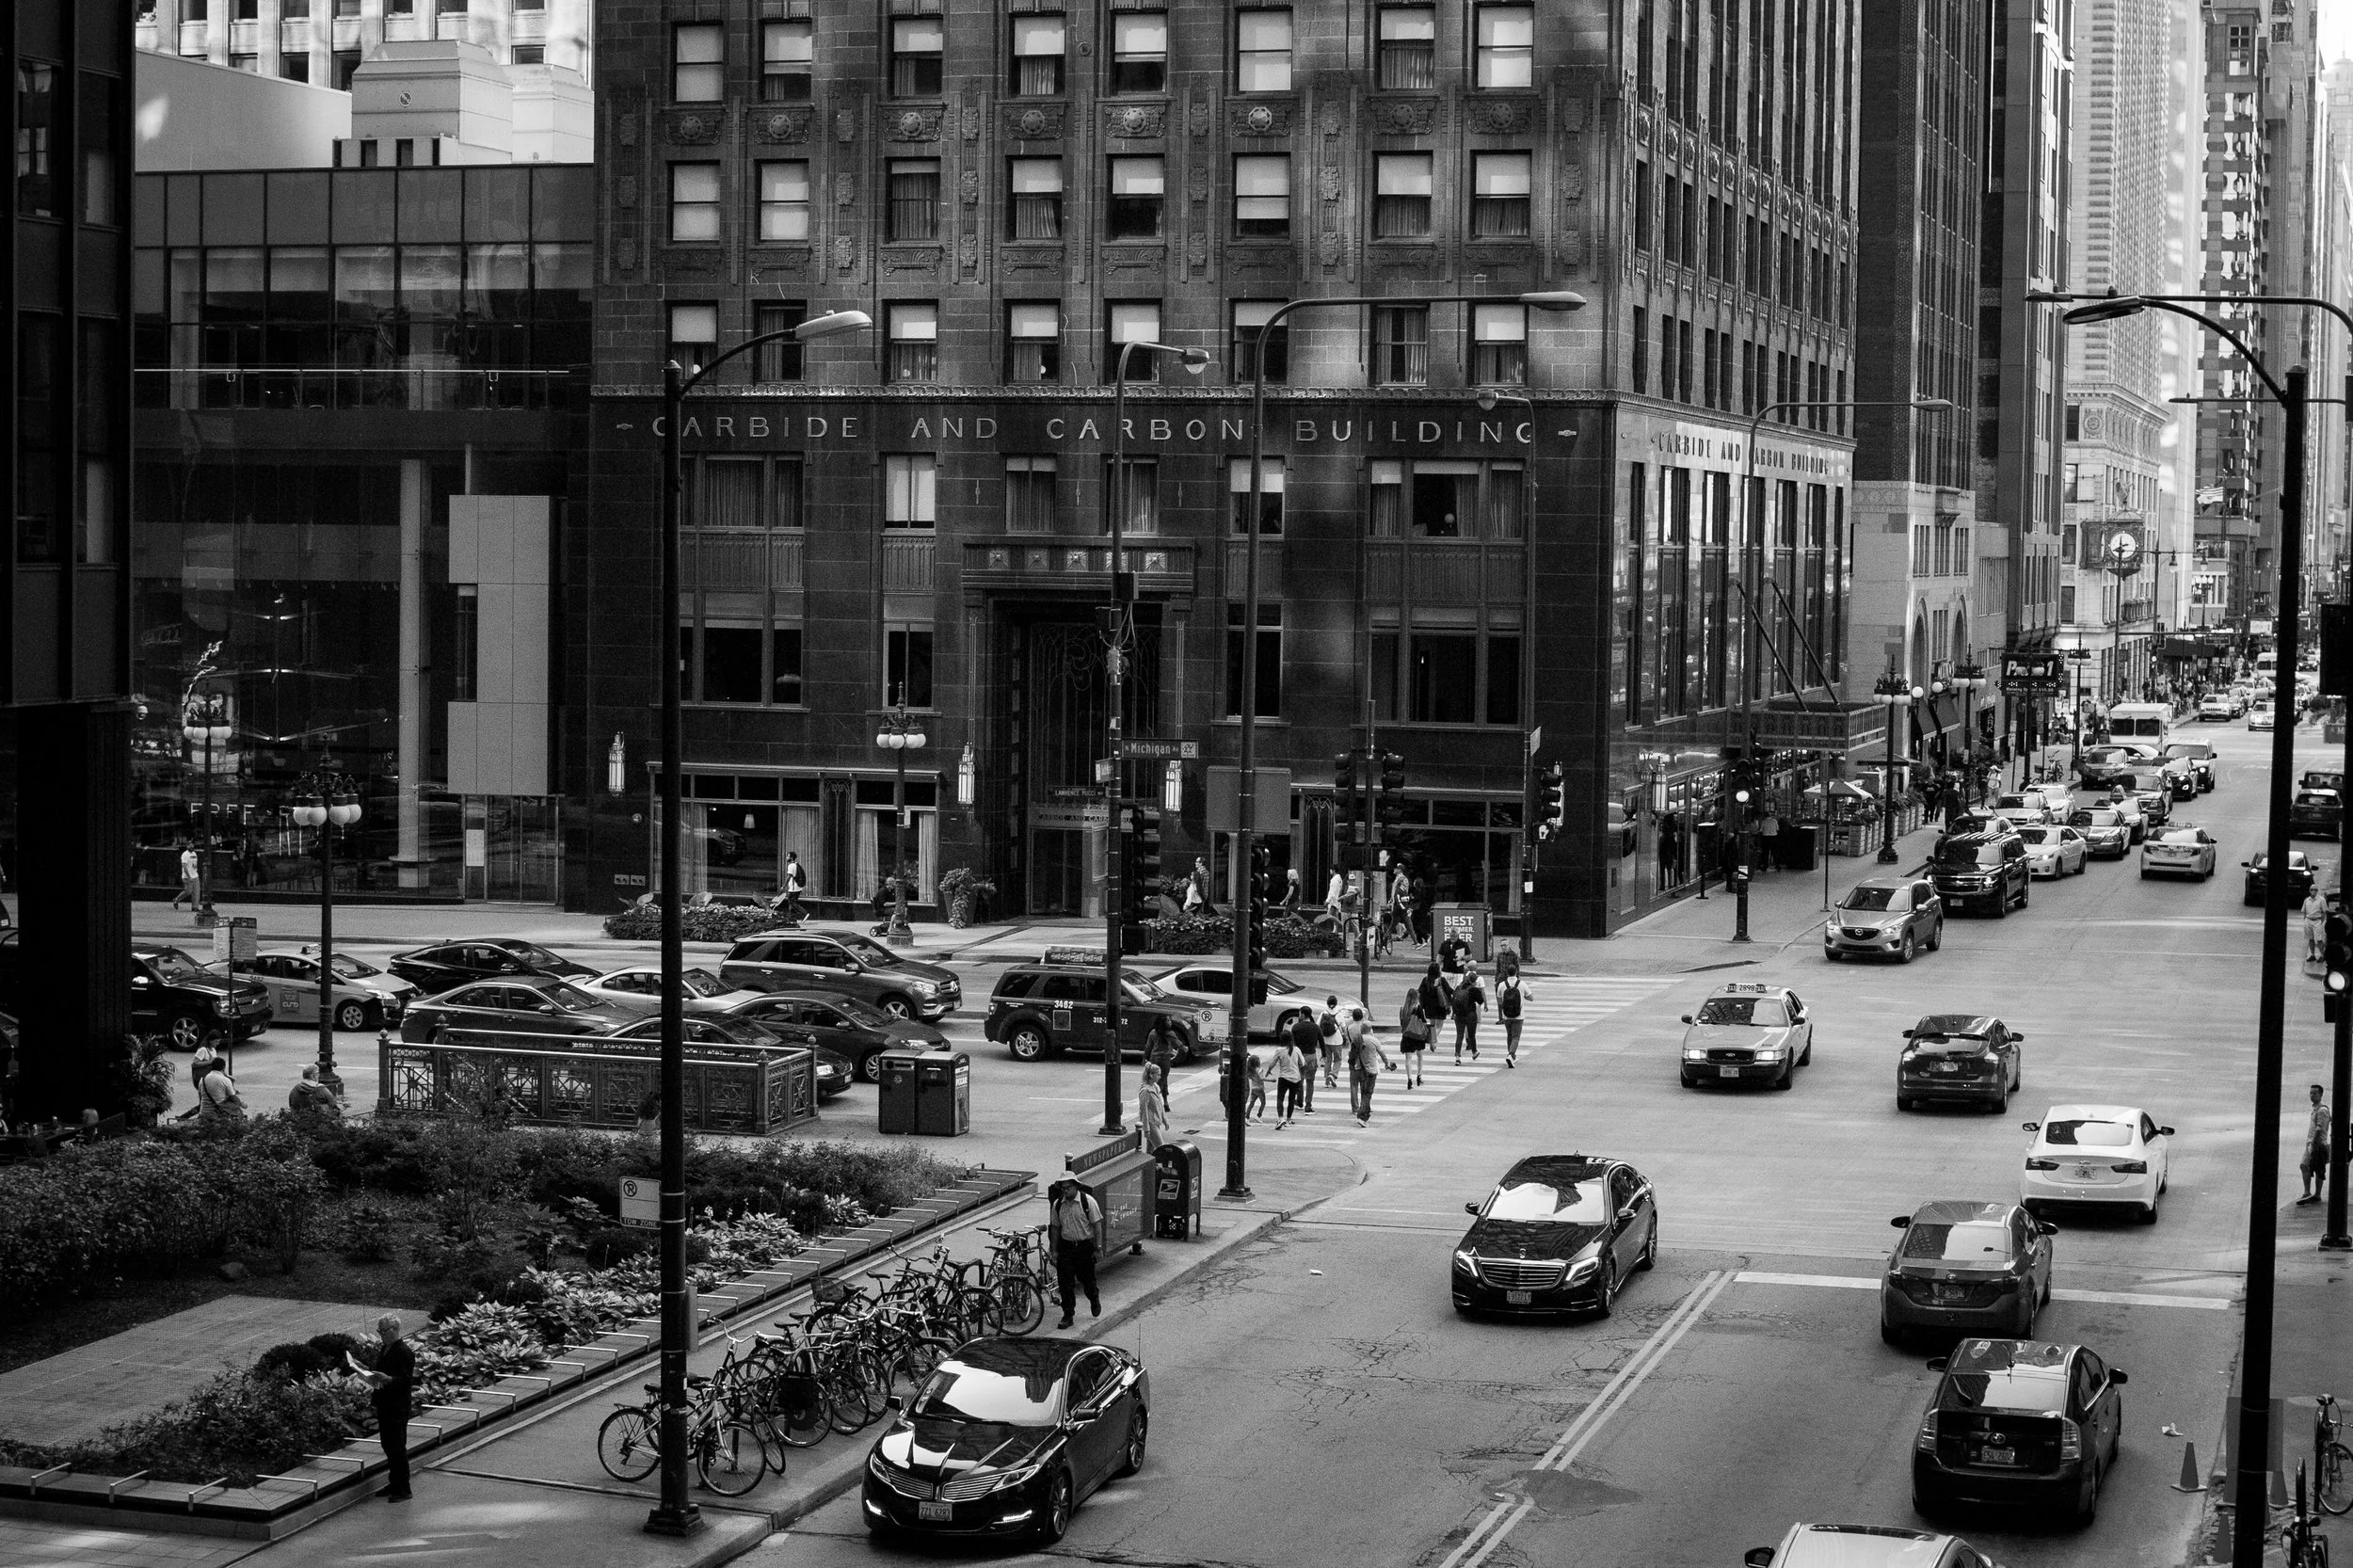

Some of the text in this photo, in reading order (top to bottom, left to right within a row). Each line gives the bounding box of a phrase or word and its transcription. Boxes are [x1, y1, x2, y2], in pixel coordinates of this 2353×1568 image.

[652, 416, 1532, 443] CARBIDE AND CARBON BUILDING
[1658, 431, 1830, 475] CARBIDE AND ARBON BUILDING
[1130, 742, 1171, 758] Michigan
[1444, 916, 1474, 926] BEST.
[1083, 1140, 1127, 1168] NEWSPAPERS
[624, 1217, 657, 1227] TOW ZONE
